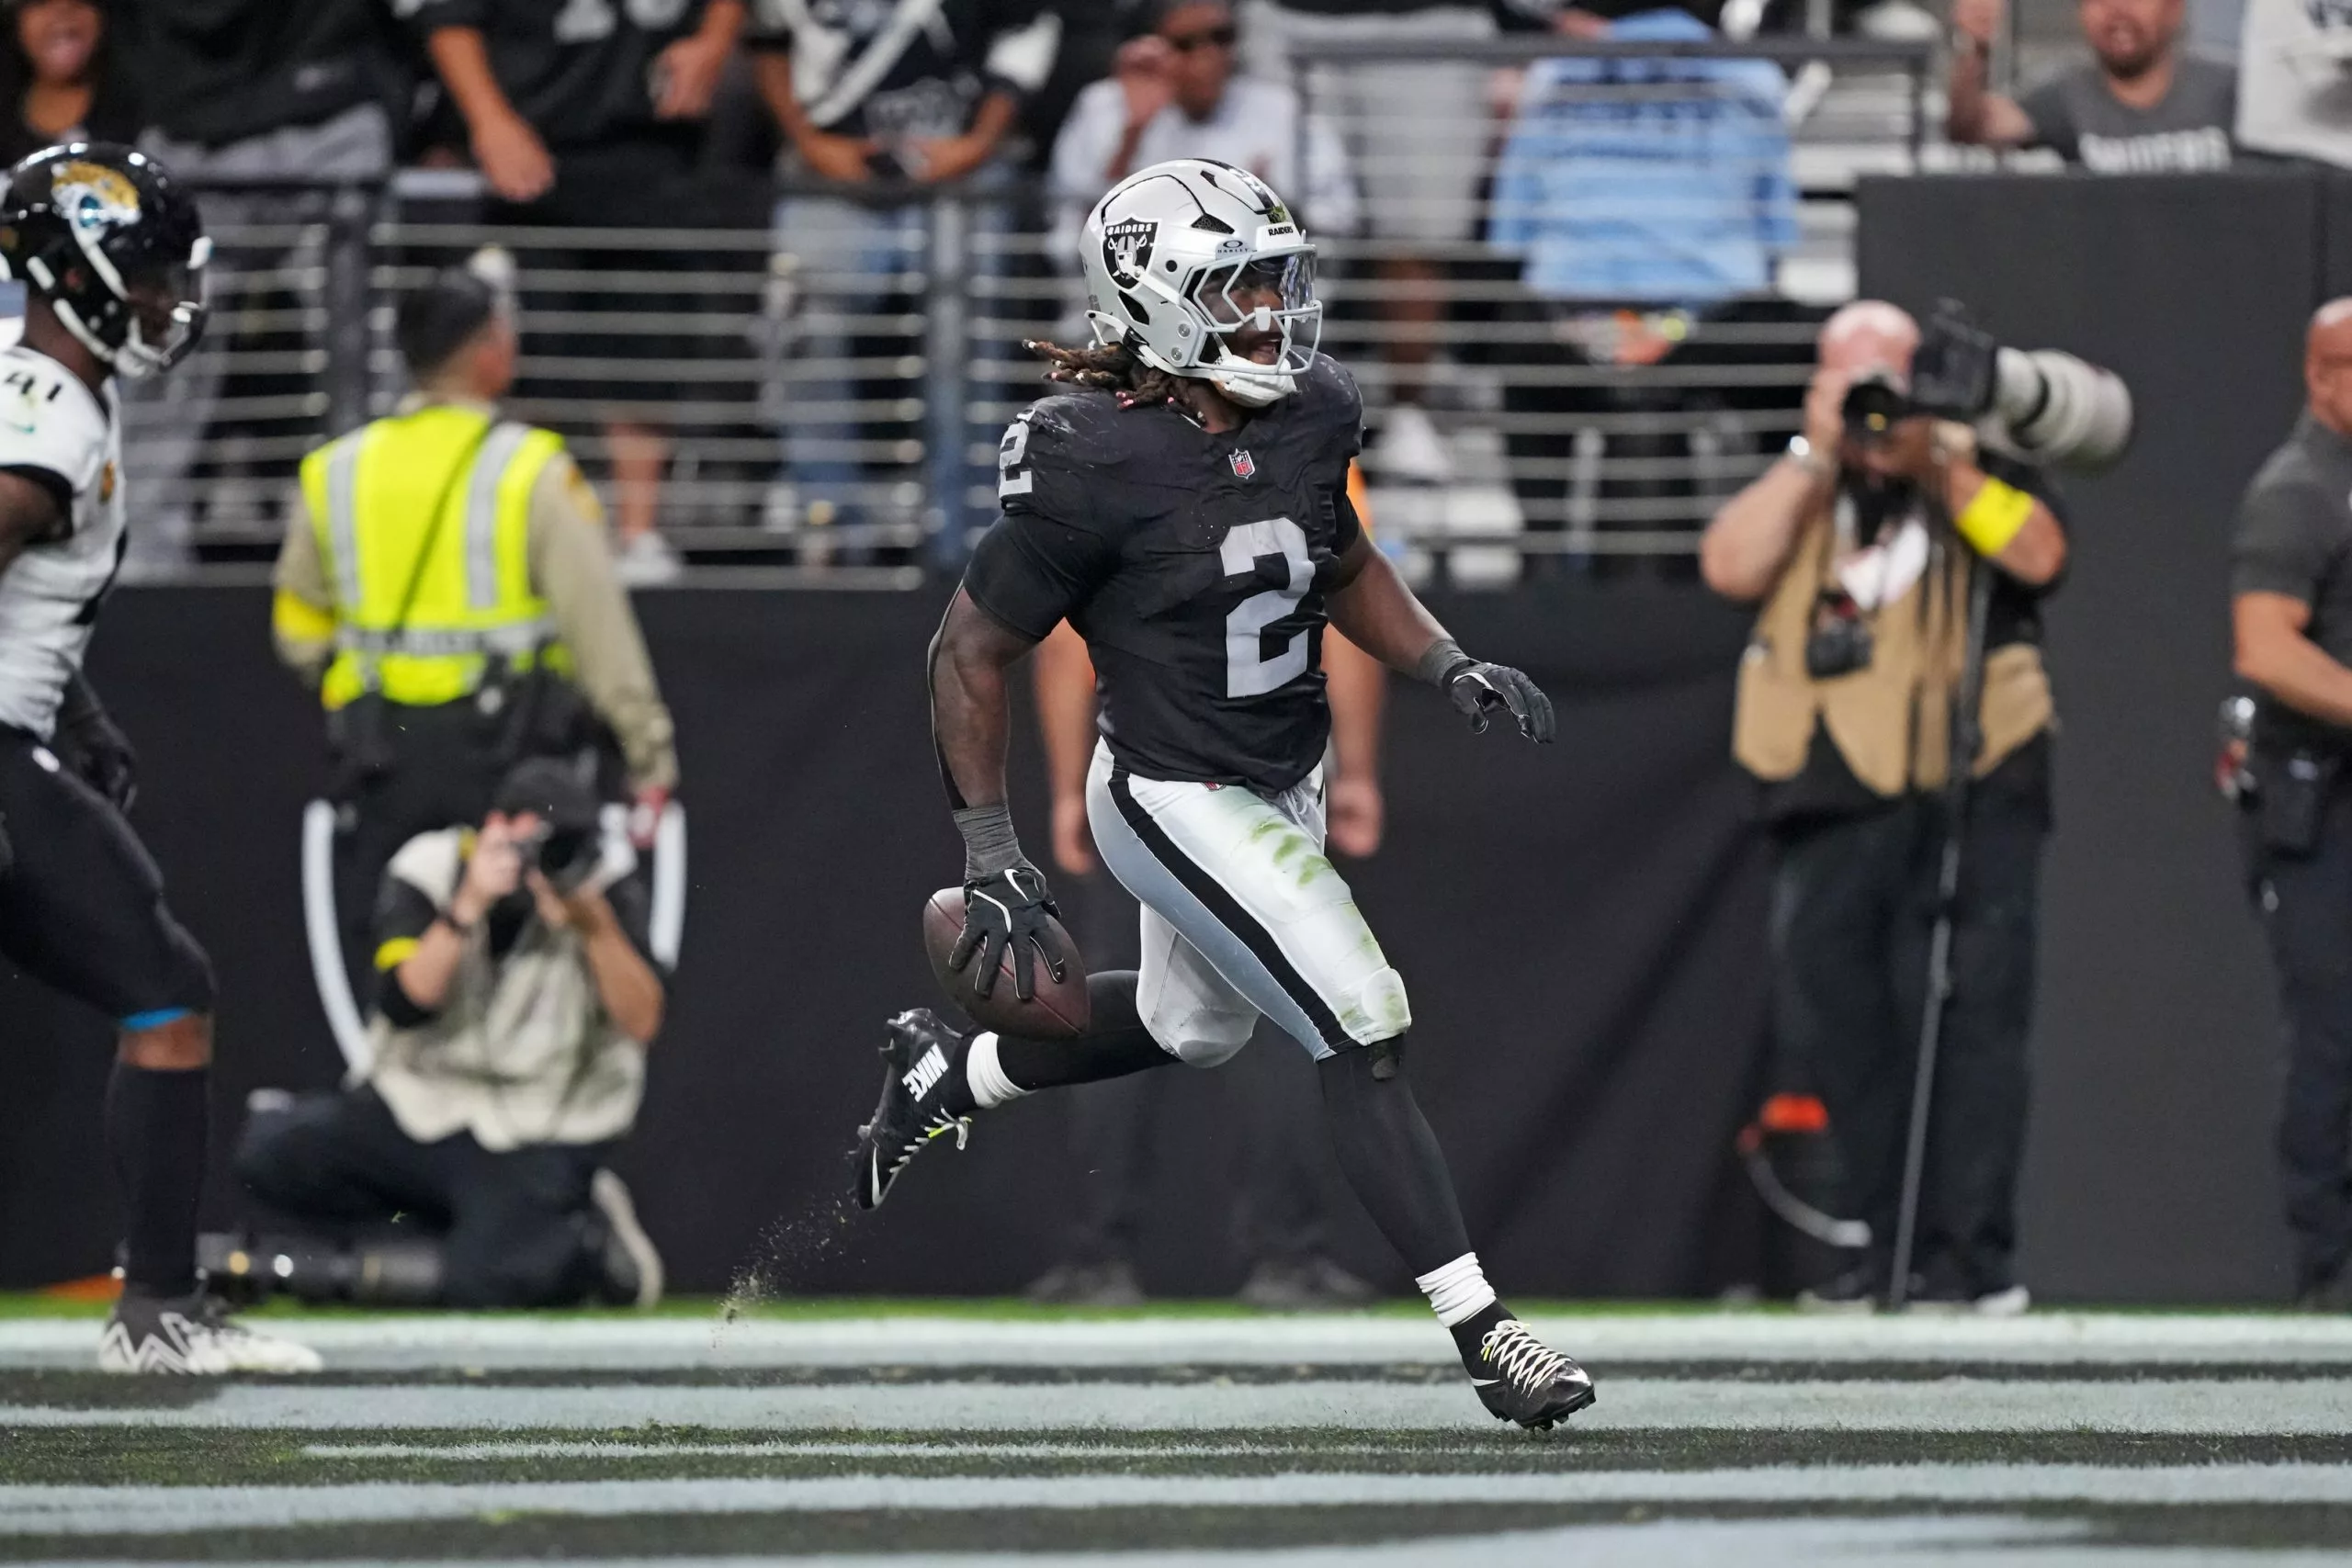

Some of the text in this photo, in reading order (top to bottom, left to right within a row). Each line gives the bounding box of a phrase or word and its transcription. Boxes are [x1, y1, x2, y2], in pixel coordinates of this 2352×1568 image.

[1105, 223, 1153, 236] RAIDERS
[1268, 226, 1294, 236] RAIDERS
[5, 370, 62, 402] 41
[998, 420, 1033, 498] 2
[1219, 516, 1316, 698] 2
[901, 1042, 949, 1102] NIKE
